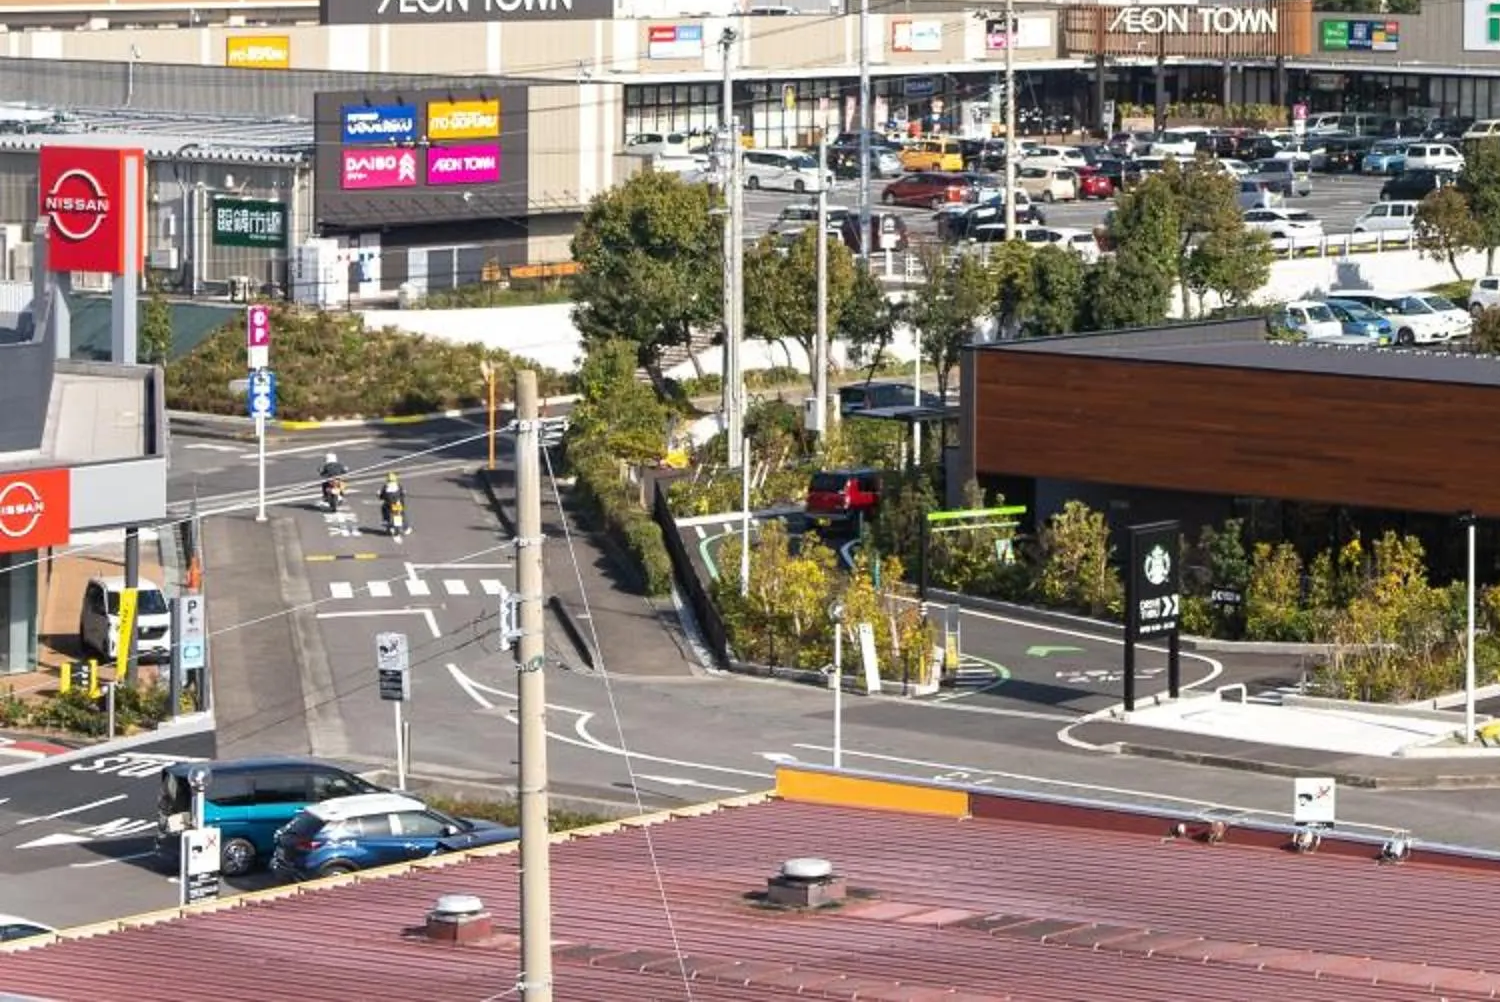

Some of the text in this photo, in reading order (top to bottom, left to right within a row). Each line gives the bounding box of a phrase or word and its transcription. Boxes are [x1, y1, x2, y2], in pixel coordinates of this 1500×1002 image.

[1197, 7, 1278, 33] TOWN
[464, 156, 495, 172] TOWN
[46, 197, 110, 212] NISSAN
[0, 501, 45, 515] ISSAN
